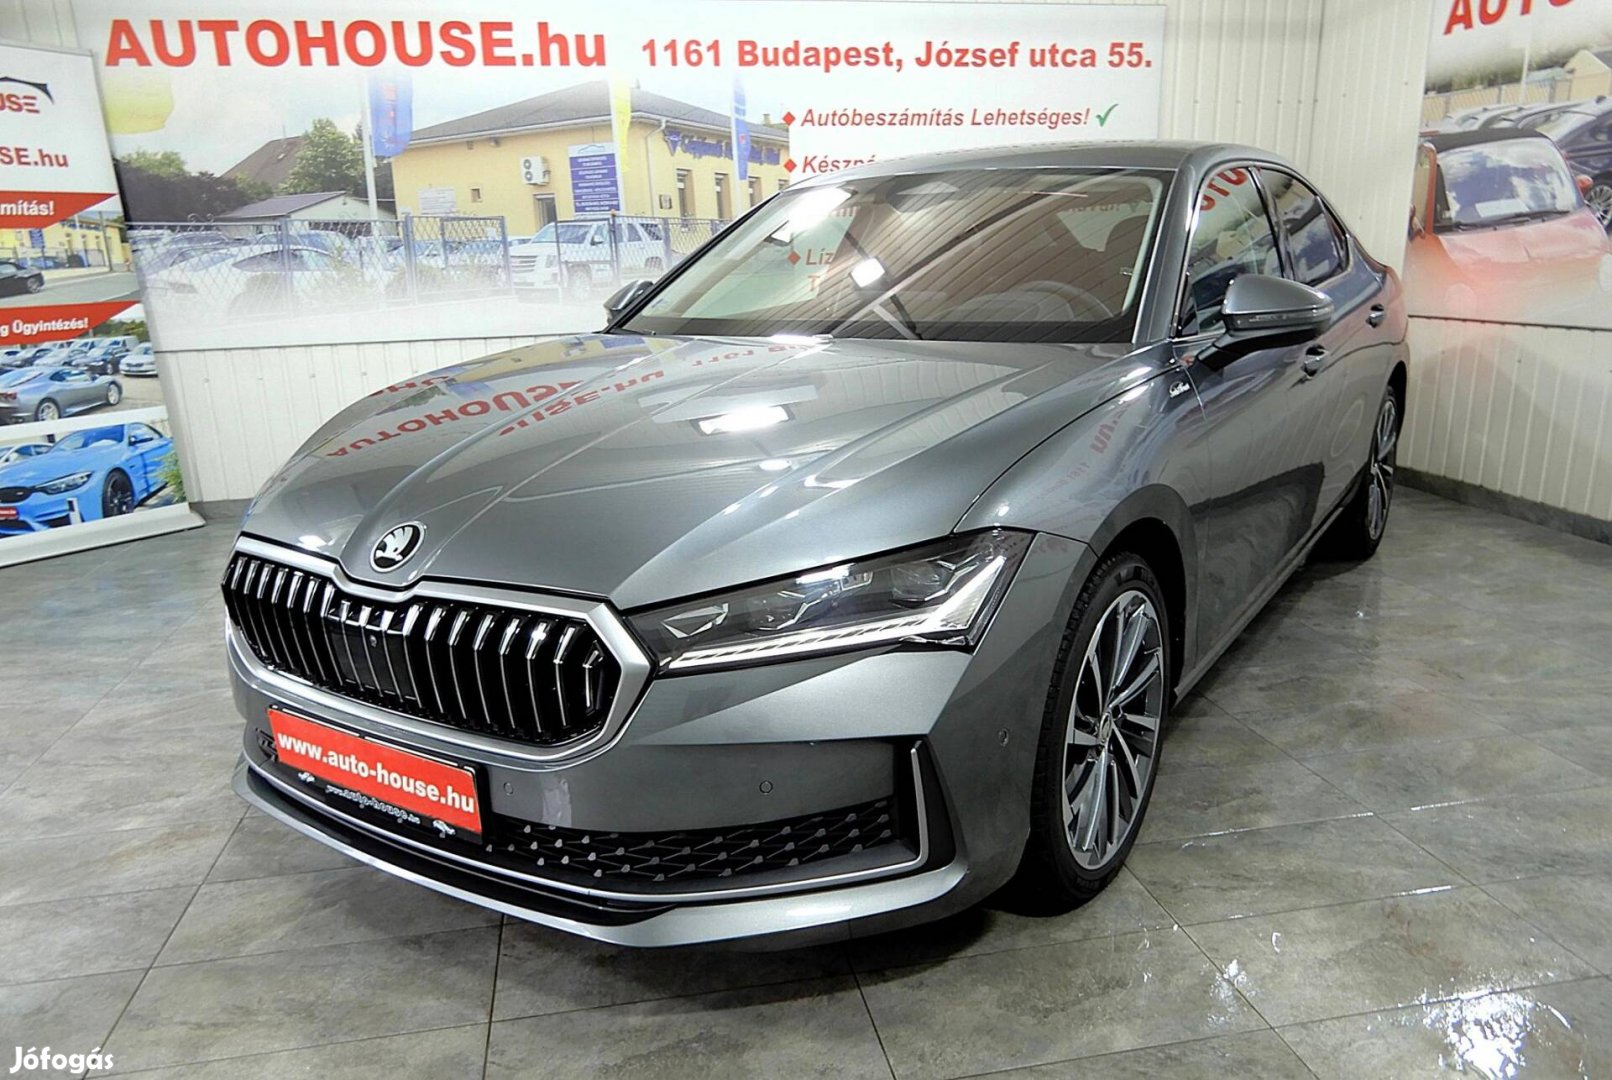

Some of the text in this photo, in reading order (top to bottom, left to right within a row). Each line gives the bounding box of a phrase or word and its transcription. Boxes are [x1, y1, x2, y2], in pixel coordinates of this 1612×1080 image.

[105, 19, 1152, 73] AUTOHOUSE.hu 1161 Budapest, József utca 55.
[801, 108, 1090, 130] Autóbeszámítás Lehetséges!
[277, 732, 475, 814] www.auto-house.hu
